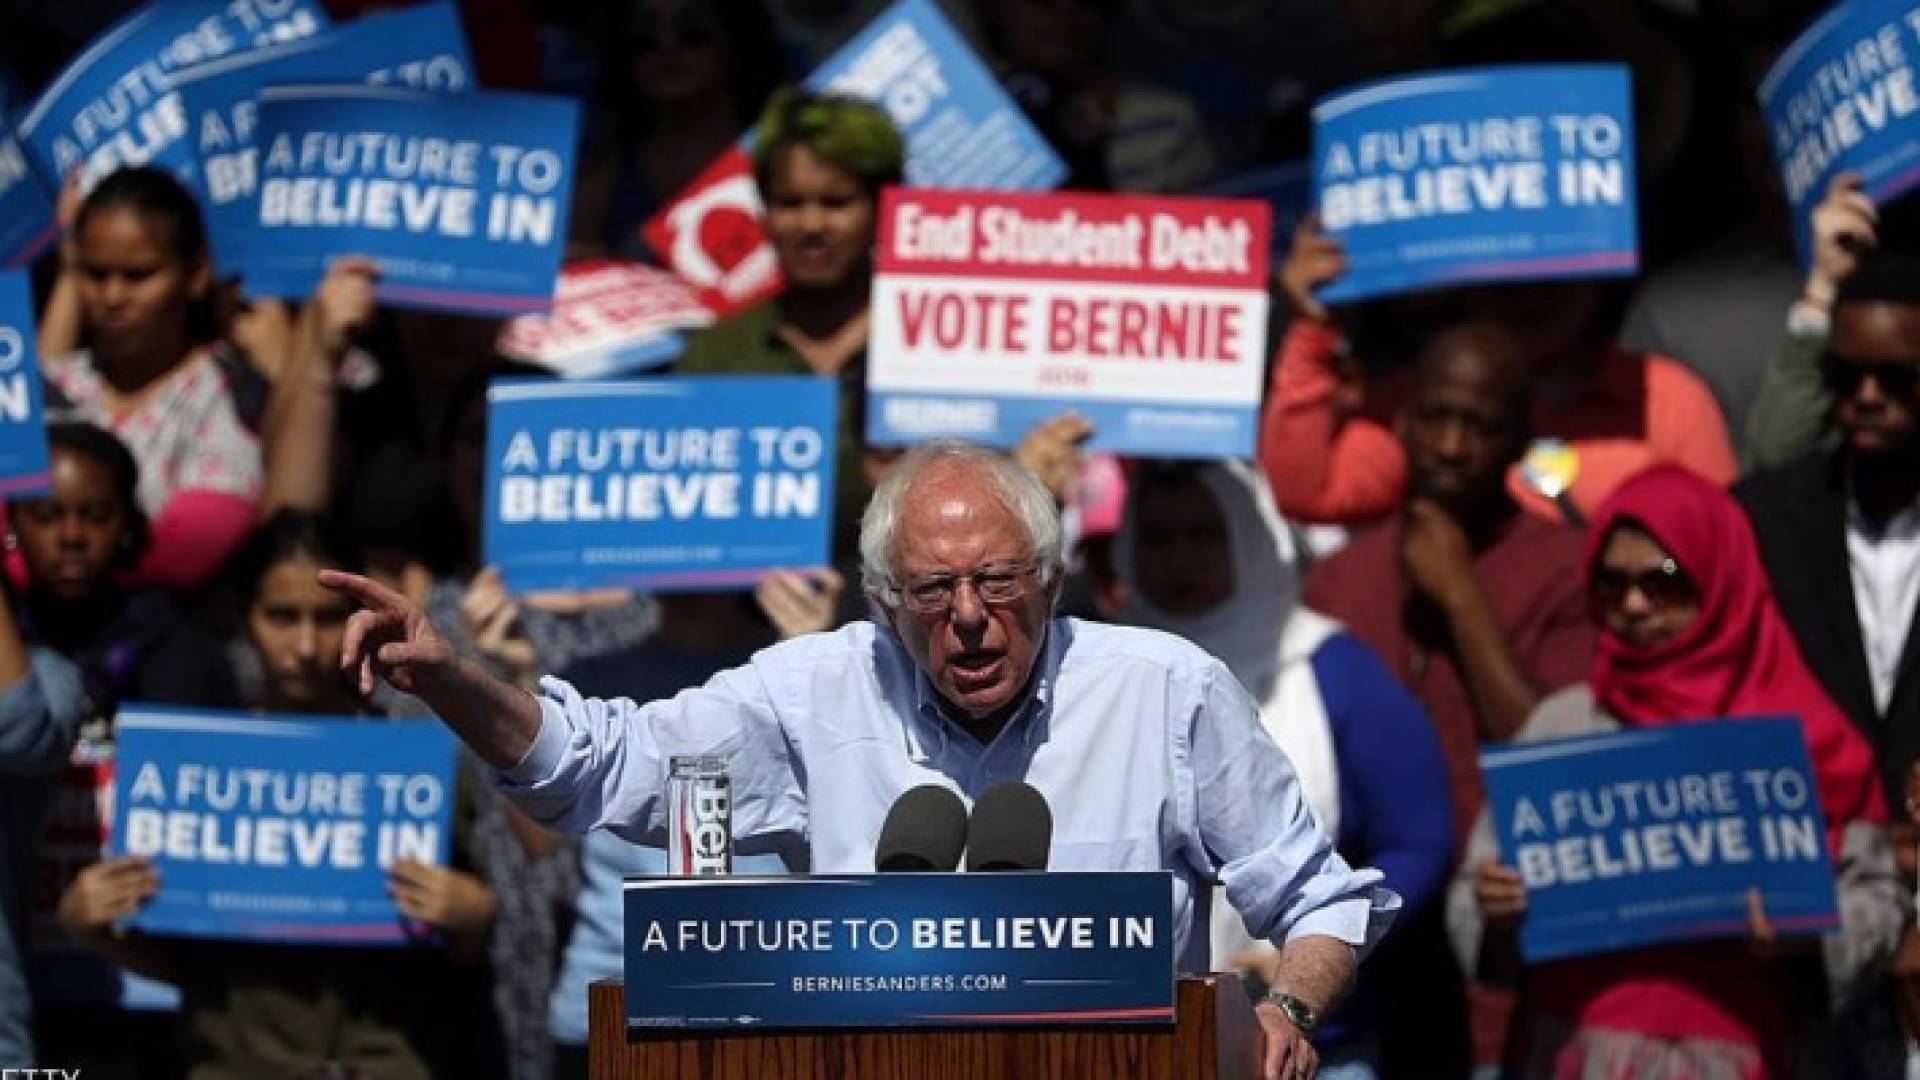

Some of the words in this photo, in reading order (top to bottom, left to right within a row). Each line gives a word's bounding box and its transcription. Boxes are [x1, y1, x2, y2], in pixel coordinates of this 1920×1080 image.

[266, 133, 294, 174] A
[302, 132, 482, 184] FUTURE
[489, 145, 562, 194] TO
[1323, 142, 1355, 178] A
[1359, 115, 1543, 174] FUTURE
[1551, 113, 1623, 158] TO
[260, 177, 478, 237] BELIEVE
[488, 194, 556, 246] IN
[1320, 160, 1549, 232] BELIEVE
[1559, 159, 1623, 207] IN
[894, 203, 975, 262] End
[977, 207, 1142, 268] Student
[1150, 213, 1252, 273] Debt
[896, 291, 1029, 353] VOTE
[1046, 298, 1241, 362] BERNIE
[503, 430, 539, 472] A
[547, 427, 741, 471] FUTURE
[750, 426, 823, 469] TO
[501, 473, 740, 522] BELIEVE
[752, 471, 821, 519] IN
[130, 761, 165, 806] A
[175, 764, 366, 815] FUTURE
[375, 773, 444, 817] TO
[1511, 796, 1545, 840] A
[1551, 771, 1739, 832] FUTURE
[1743, 766, 1810, 809] TO
[125, 806, 366, 869] BELIEVE
[377, 820, 438, 870] IN
[1516, 816, 1752, 889] BELIEVE
[1760, 814, 1819, 864] IN
[642, 919, 668, 951] A
[677, 919, 834, 951] FUTURE
[842, 919, 899, 952] TO
[911, 917, 1095, 949] BELIEVE
[1109, 917, 1155, 949] IN
[792, 974, 1008, 993] BERNIESANDERS.COM
